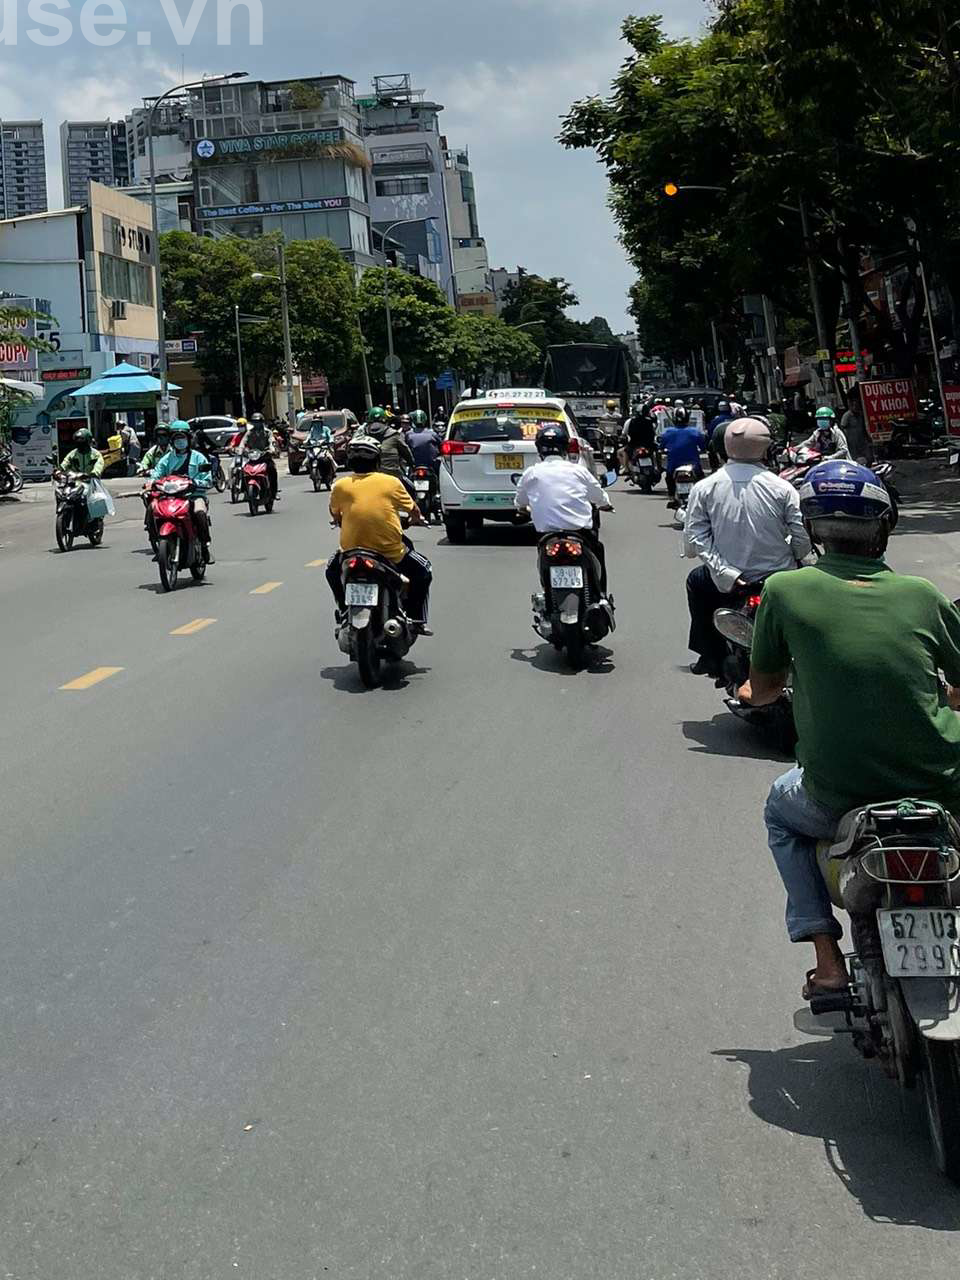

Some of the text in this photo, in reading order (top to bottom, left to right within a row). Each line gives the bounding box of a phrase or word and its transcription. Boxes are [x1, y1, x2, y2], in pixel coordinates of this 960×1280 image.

[220, 130, 339, 153] VIVA STAR COFFEE
[219, 207, 237, 216] Best
[238, 205, 264, 215] Coffee
[271, 203, 285, 212] For
[286, 202, 301, 211] The
[303, 200, 322, 209] Best
[323, 199, 342, 208] YOU
[871, 398, 909, 411] Y KHOA
